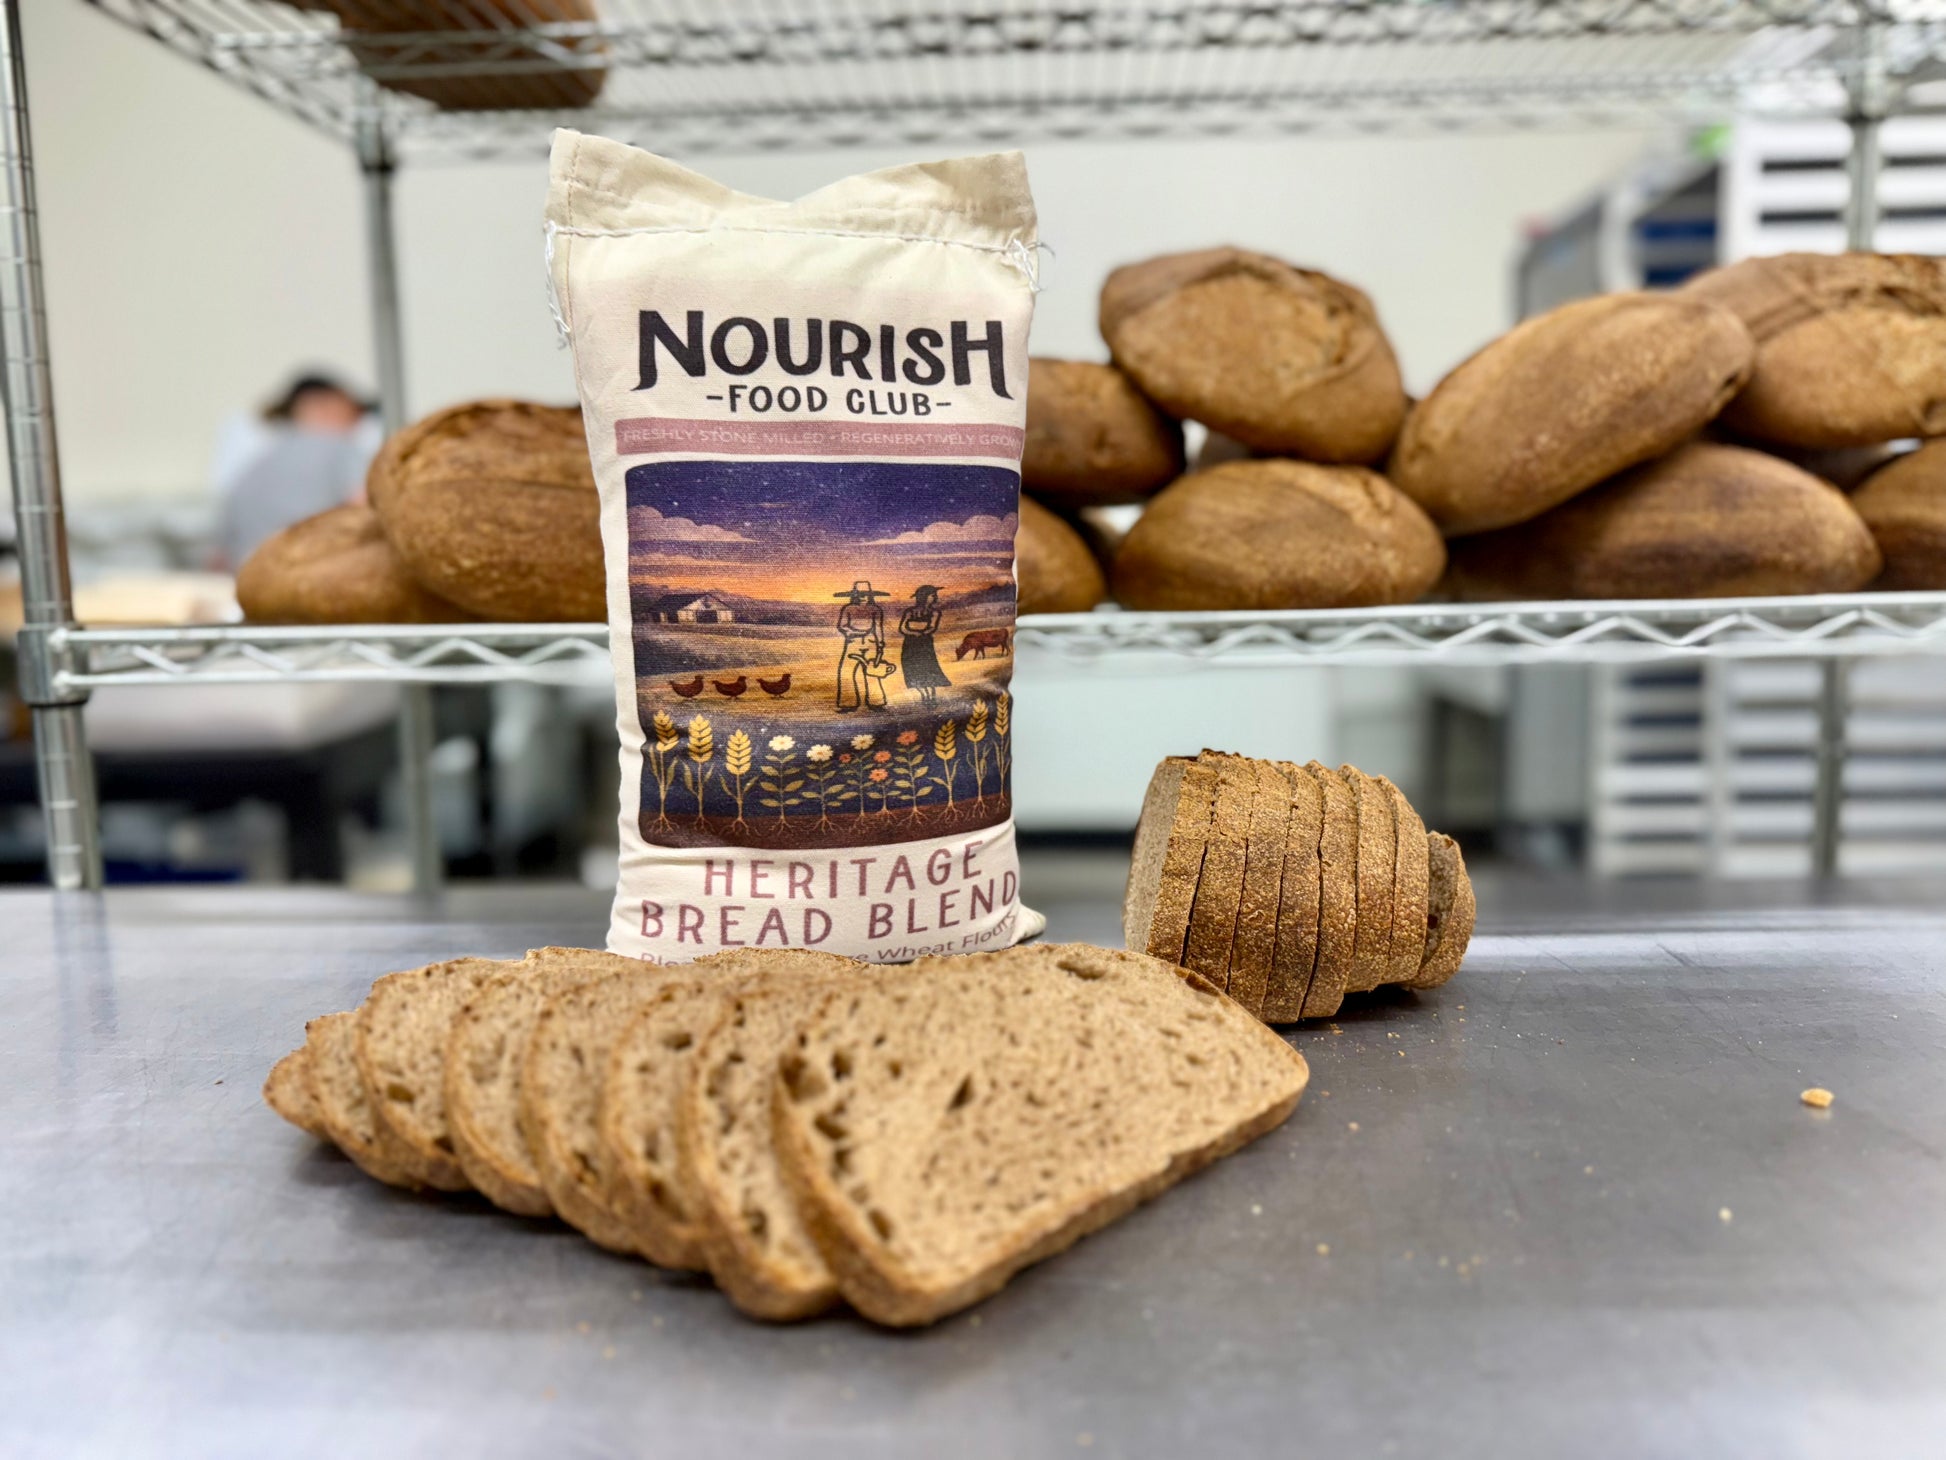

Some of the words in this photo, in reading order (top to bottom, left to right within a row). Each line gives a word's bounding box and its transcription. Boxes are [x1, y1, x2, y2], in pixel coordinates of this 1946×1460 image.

[631, 310, 1014, 399] NOURISH
[624, 428, 694, 443] FRESHLY
[700, 429, 757, 443] STONE
[763, 432, 824, 444] MILLED
[841, 432, 974, 446] REGENERATIVELY
[704, 840, 984, 899] HERITAGE
[641, 900, 832, 946] BREAD
[868, 870, 1017, 938] BLEND
[878, 942, 954, 960] Wheat
[962, 912, 1016, 948] Flours
